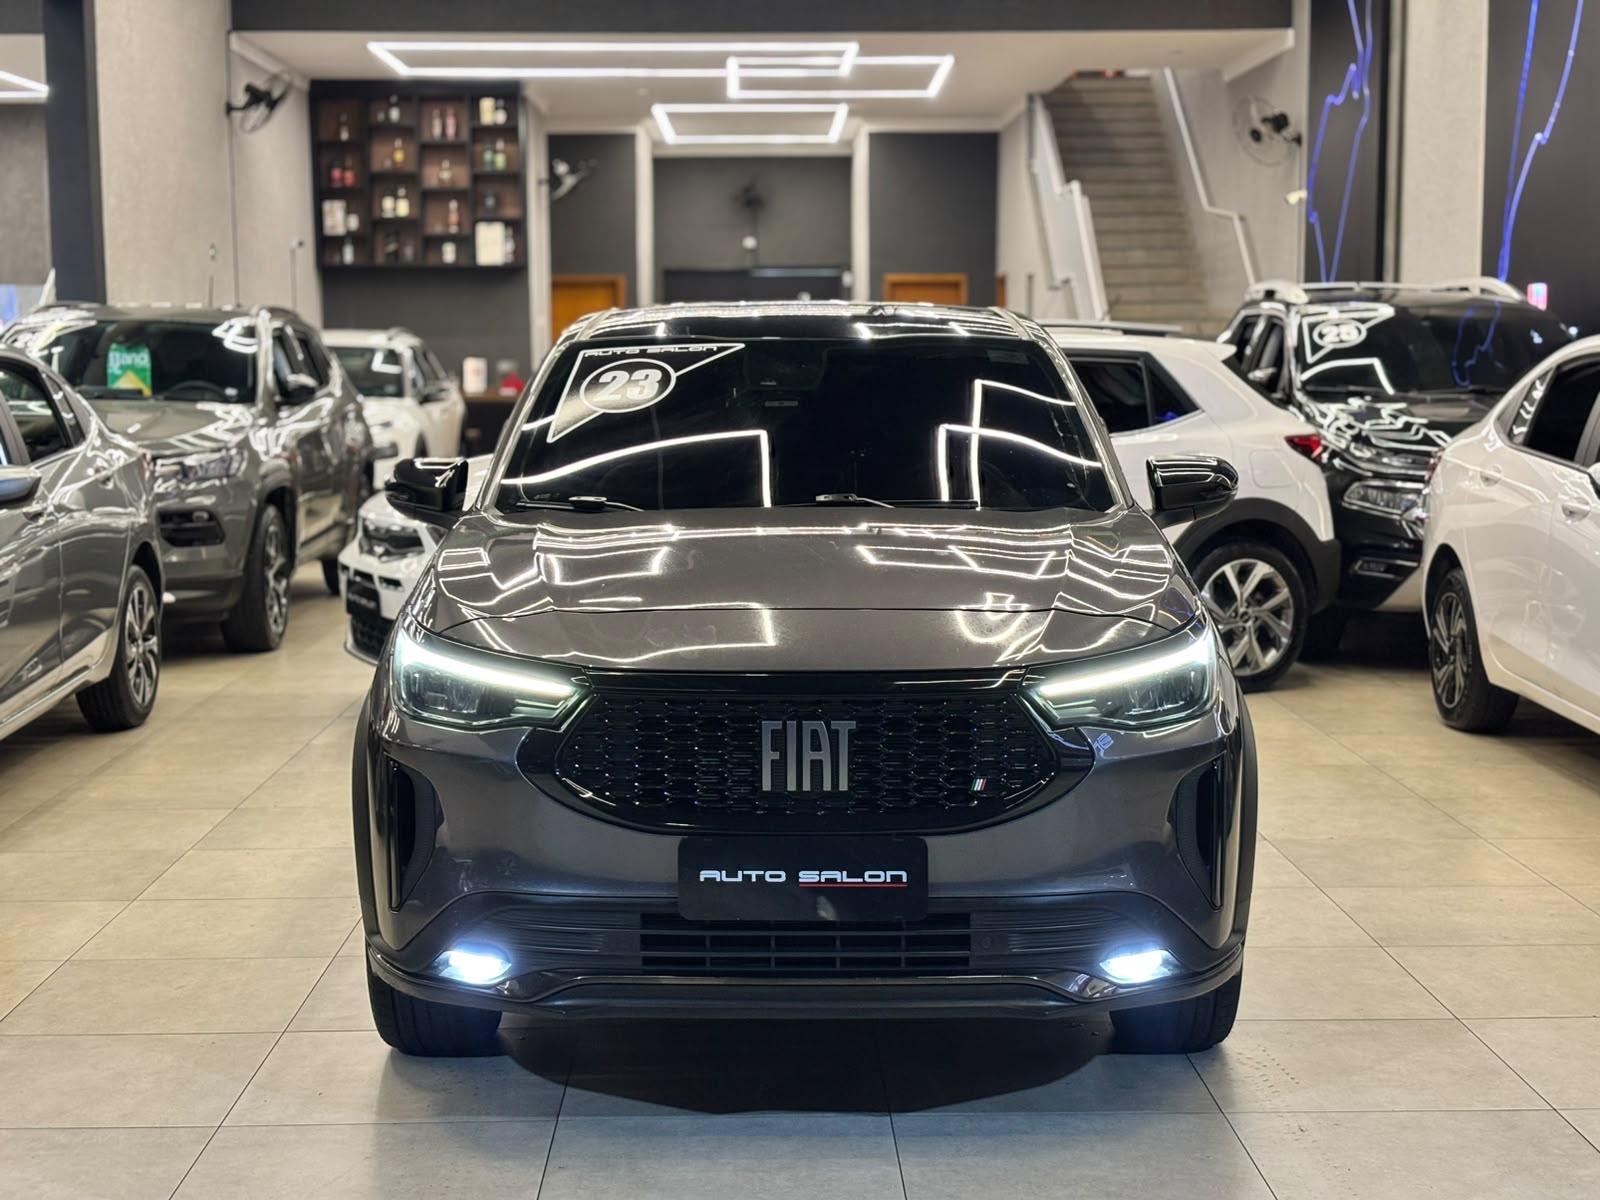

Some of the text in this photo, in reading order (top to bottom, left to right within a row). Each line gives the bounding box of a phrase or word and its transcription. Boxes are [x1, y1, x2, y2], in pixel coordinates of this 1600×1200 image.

[584, 349, 640, 357] AUTO
[593, 368, 663, 402] 23
[761, 720, 857, 792] FIAT
[699, 870, 908, 883] AUTO SALON
